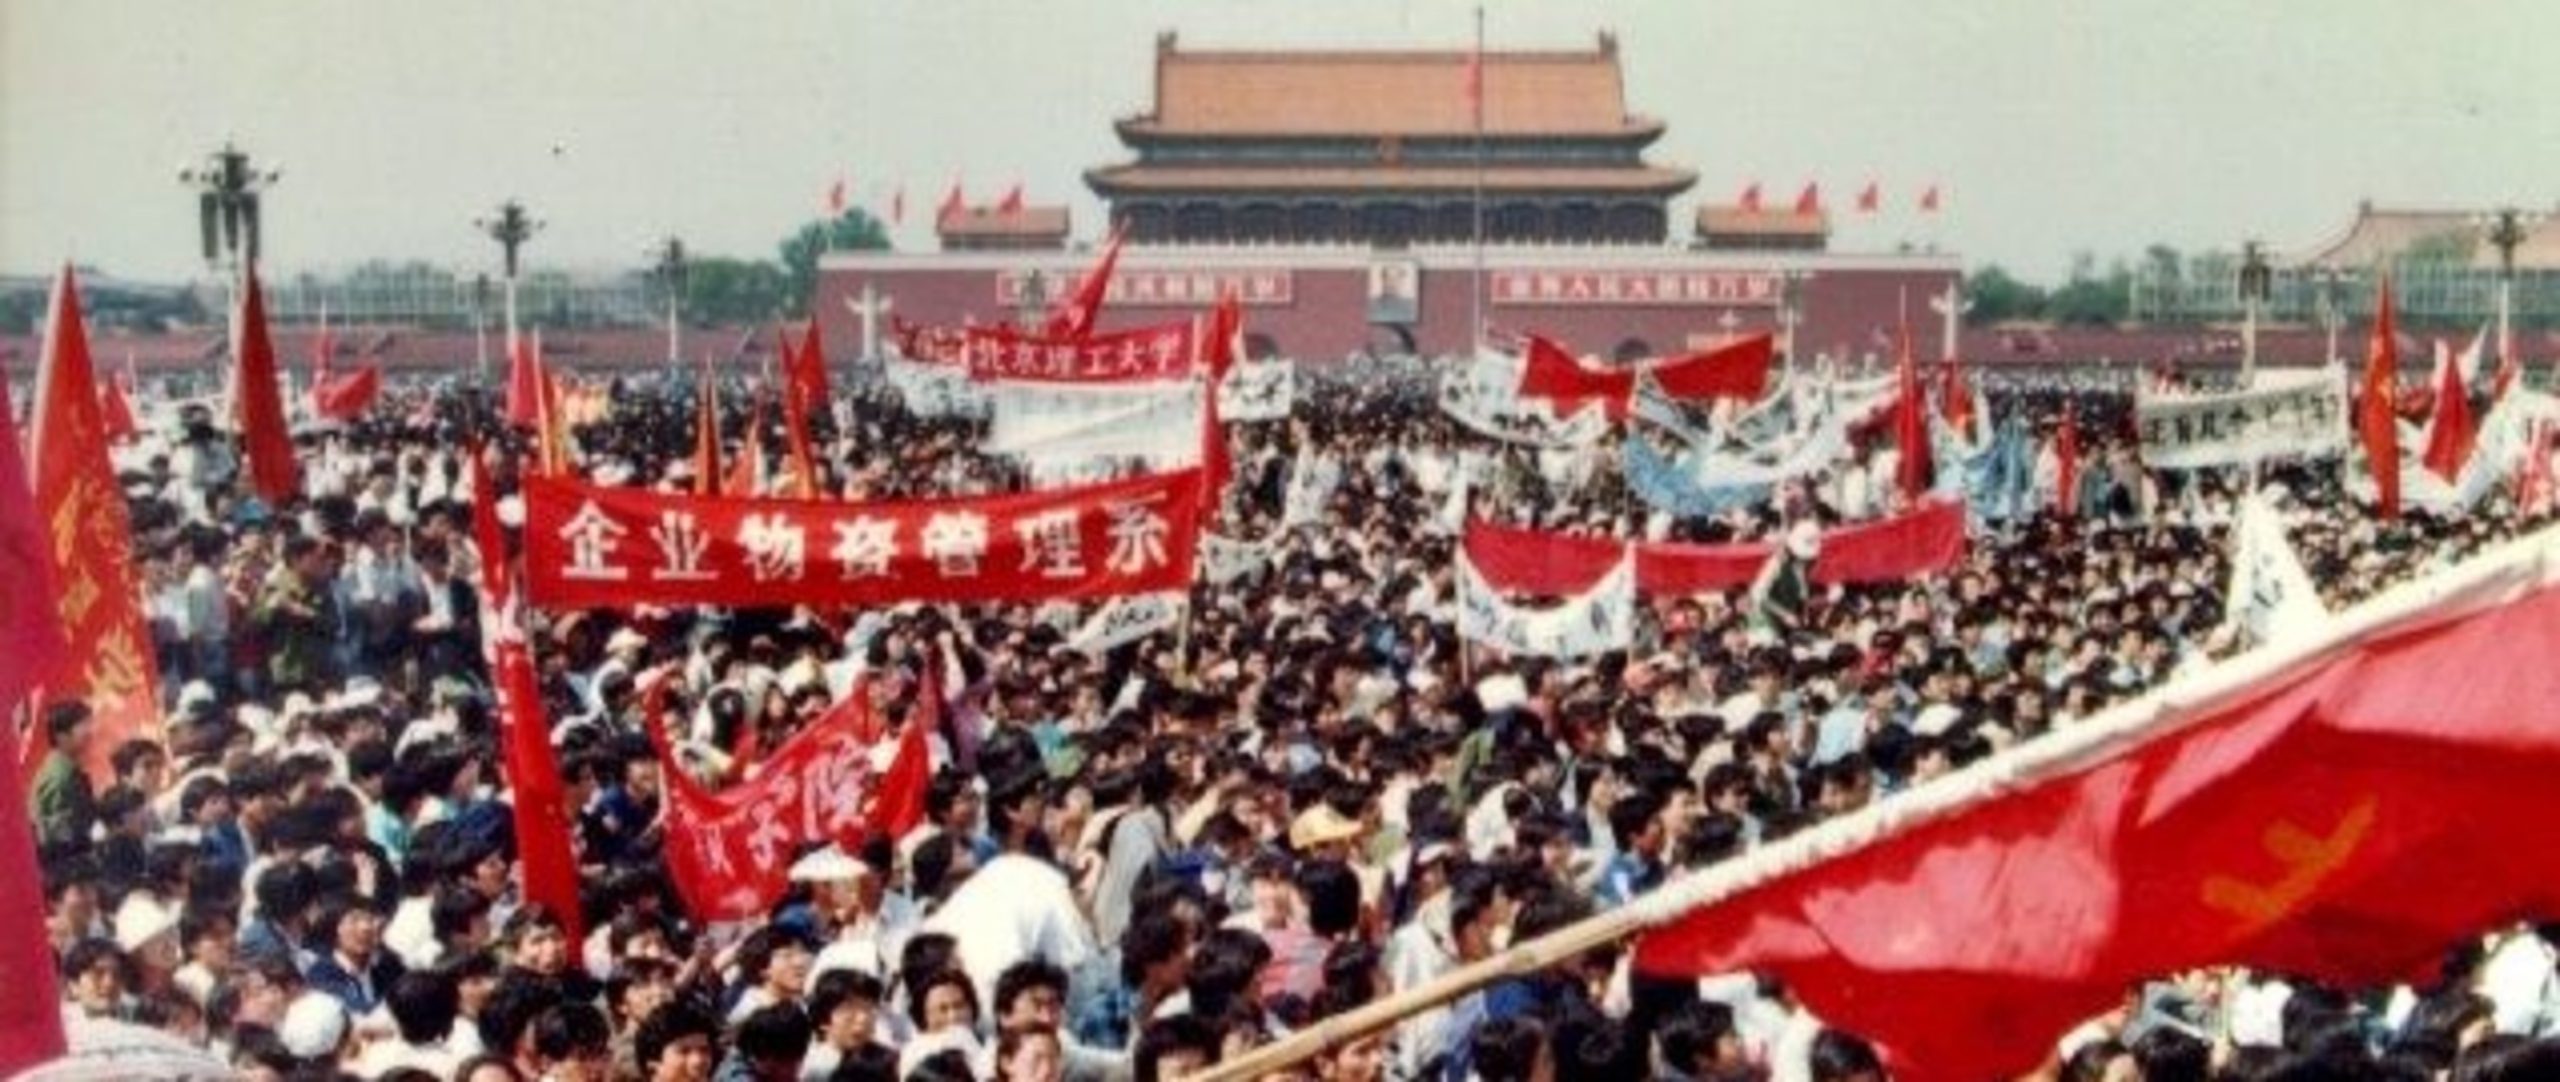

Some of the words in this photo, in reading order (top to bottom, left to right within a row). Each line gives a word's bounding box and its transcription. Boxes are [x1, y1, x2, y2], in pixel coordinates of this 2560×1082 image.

[975, 332, 1183, 377] 北京理工大学
[560, 492, 1169, 581] 企业物资管理系
